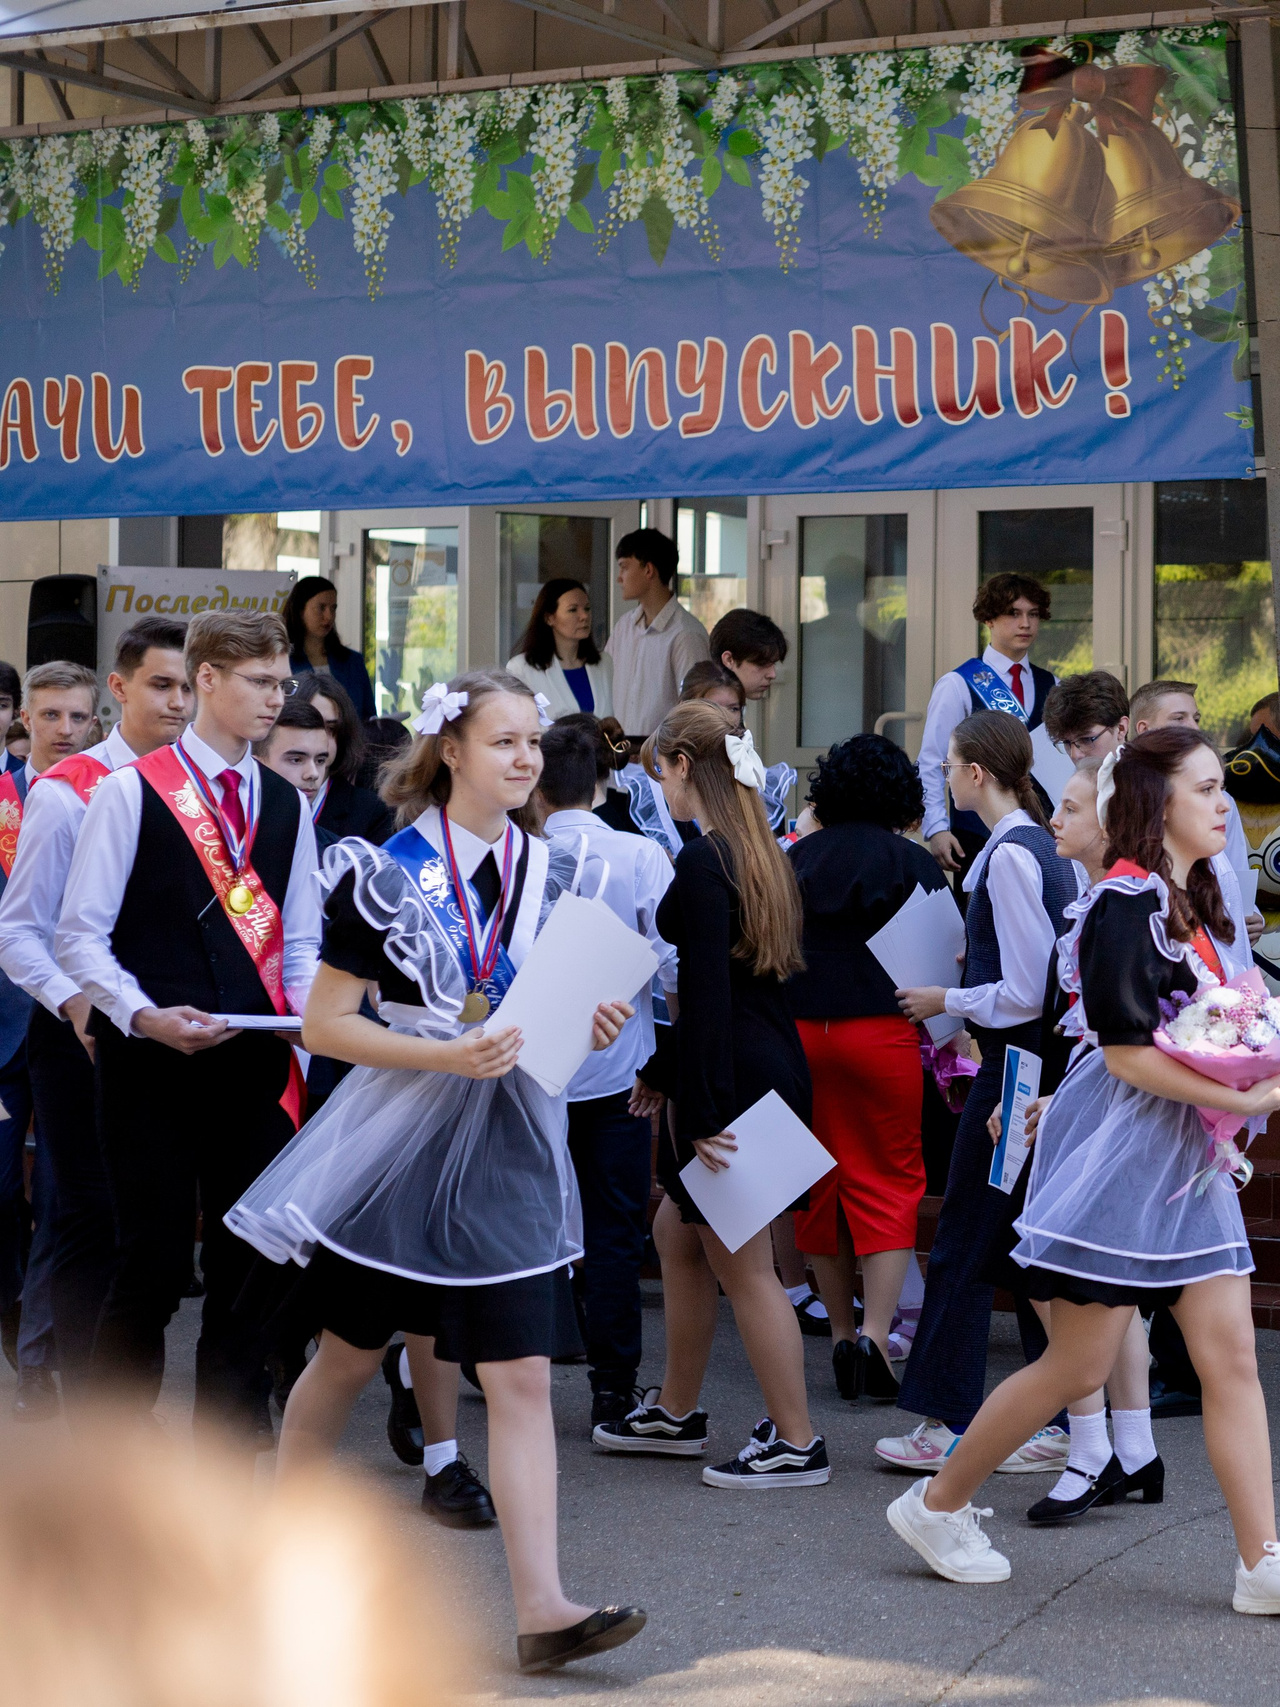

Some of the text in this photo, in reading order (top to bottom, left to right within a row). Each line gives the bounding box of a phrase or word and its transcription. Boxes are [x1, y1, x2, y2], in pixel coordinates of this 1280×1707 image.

[182, 355, 413, 456] ТЕБЕ,
[105, 584, 289, 614] Последний
[266, 952, 281, 996] 2025
